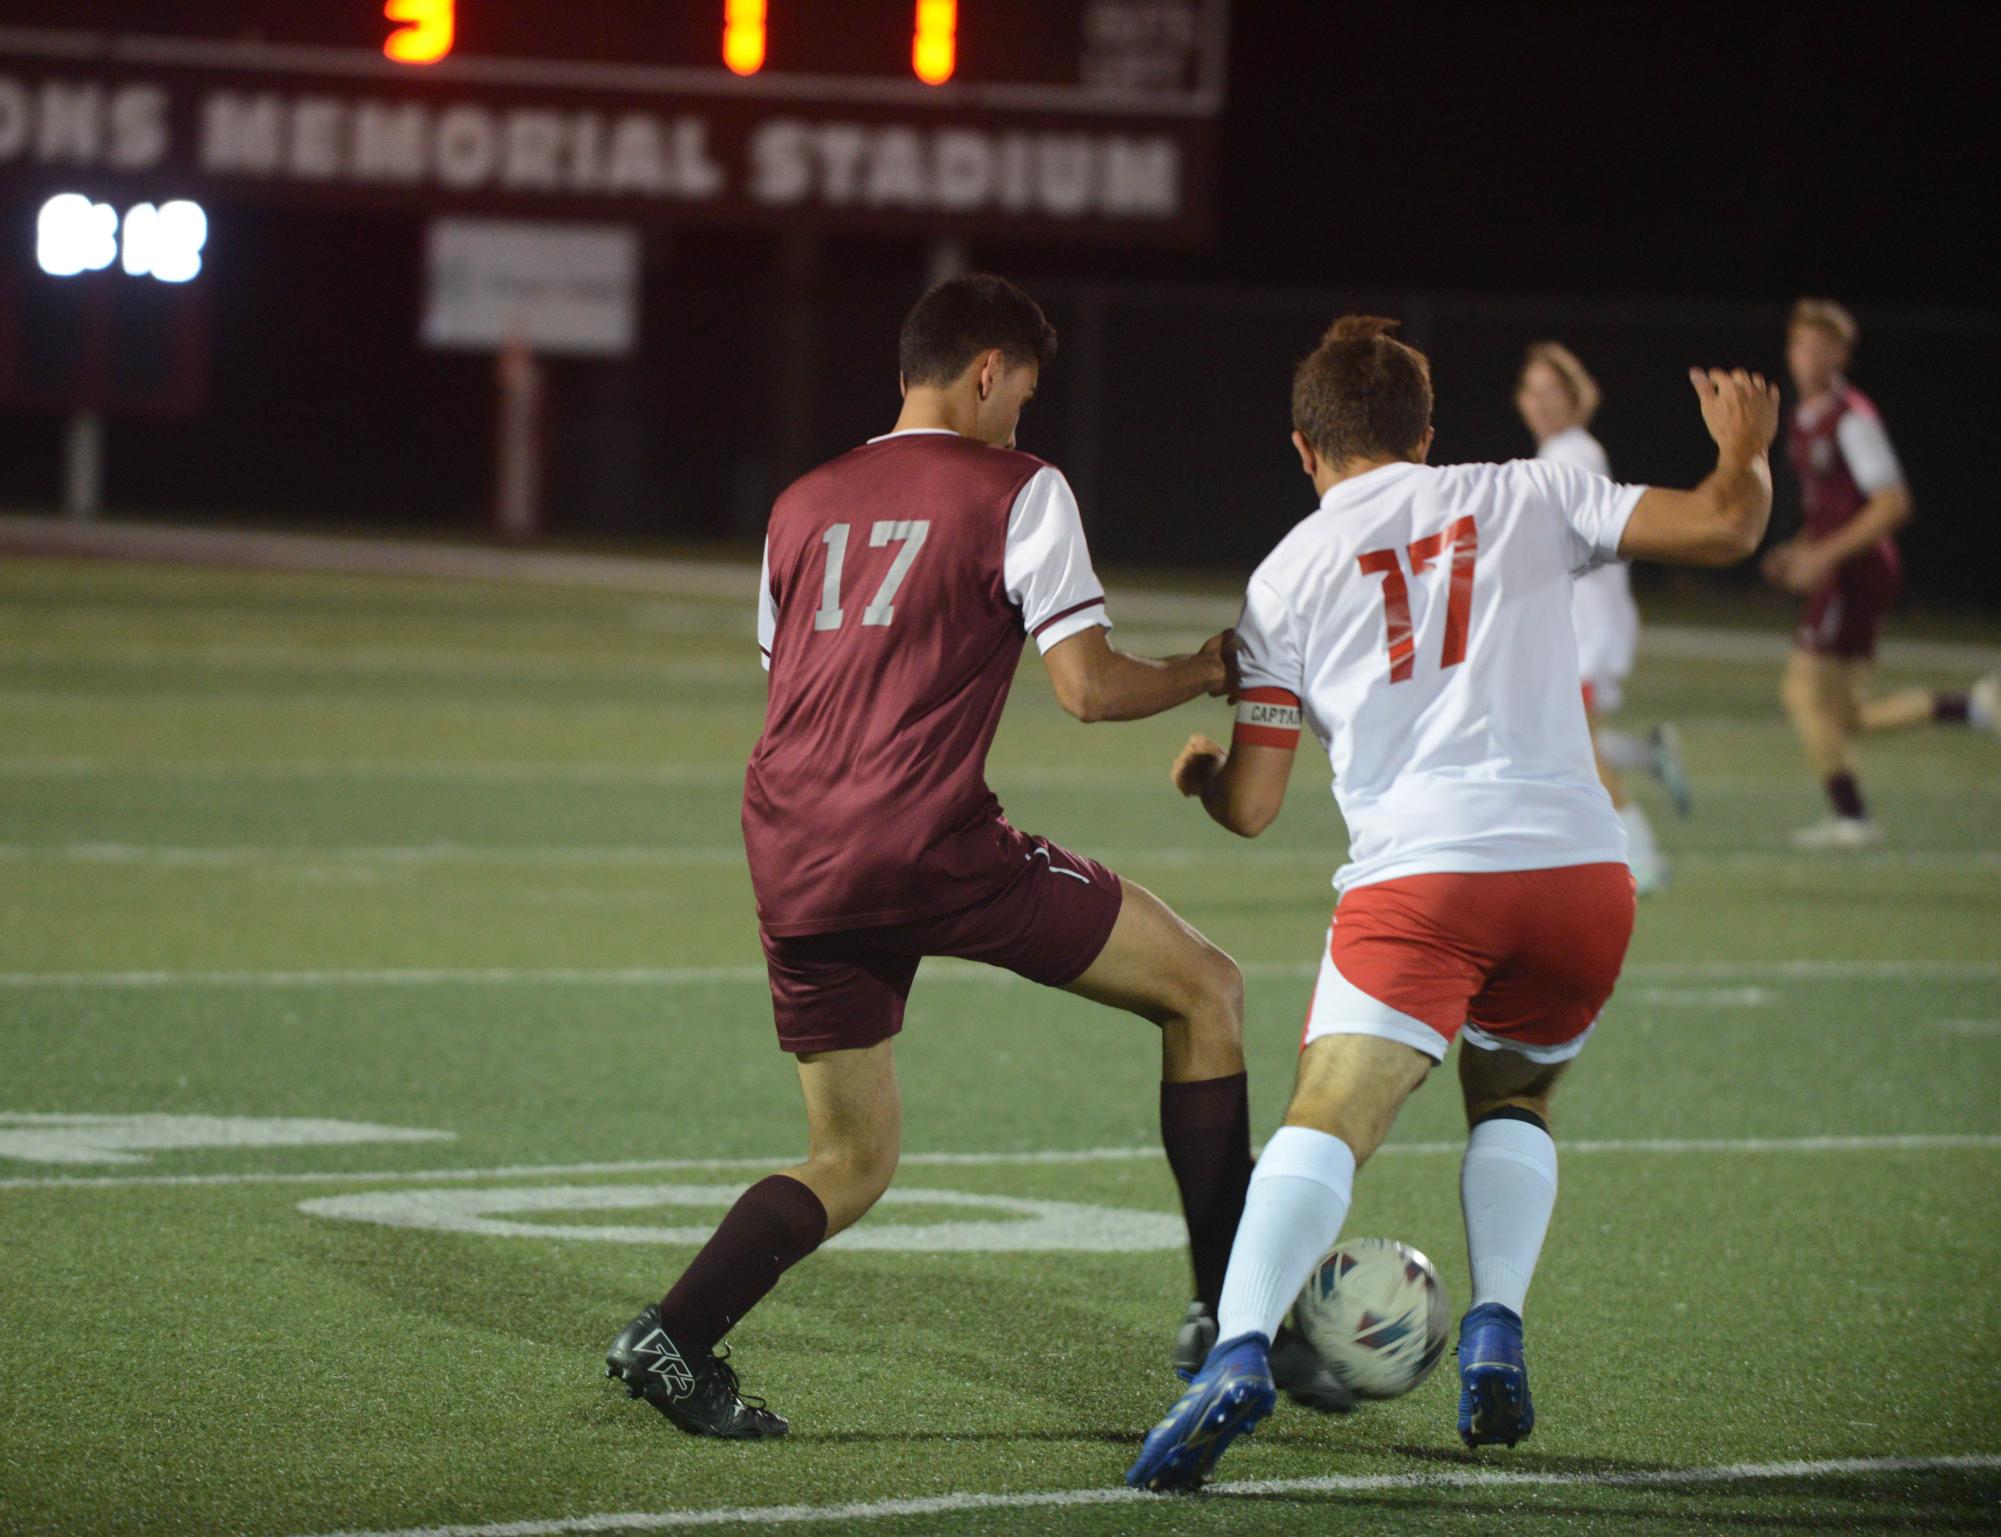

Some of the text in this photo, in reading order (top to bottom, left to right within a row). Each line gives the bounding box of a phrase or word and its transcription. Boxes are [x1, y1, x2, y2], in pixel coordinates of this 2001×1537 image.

[204, 92, 722, 195] MEMORIAL
[752, 118, 1180, 216] STADIUM
[814, 520, 931, 631] 17
[1356, 514, 1478, 685] 17
